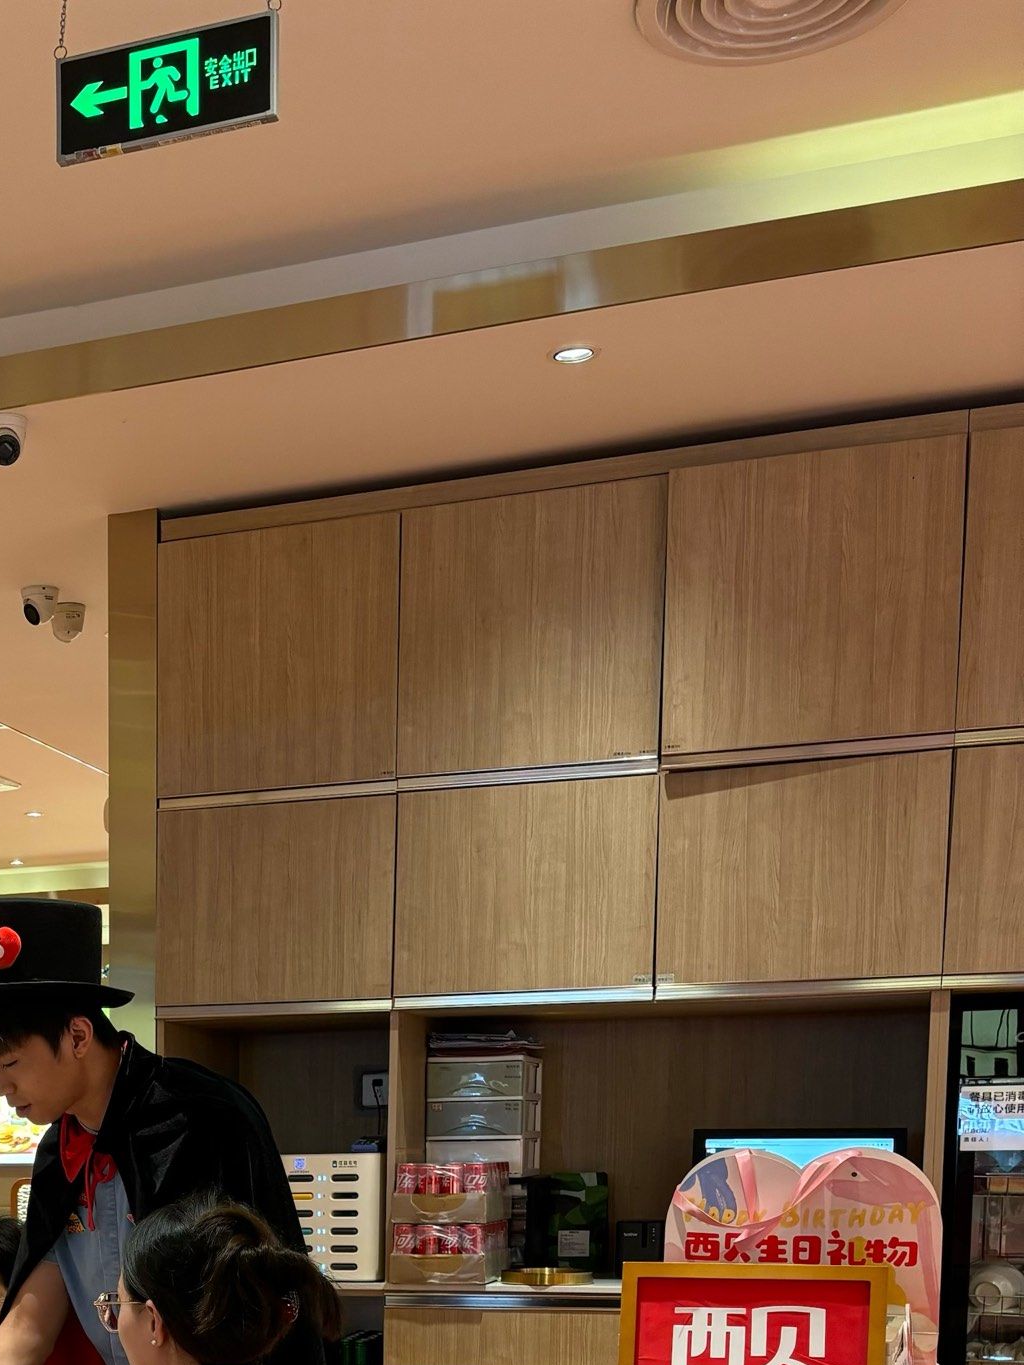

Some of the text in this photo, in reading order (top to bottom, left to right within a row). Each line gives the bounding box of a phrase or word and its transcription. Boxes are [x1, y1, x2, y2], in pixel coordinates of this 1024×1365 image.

[204, 48, 257, 77] 安全出口
[209, 68, 252, 90] EXIT
[780, 1200, 926, 1229] BIRTHDAY
[685, 1229, 919, 1267] 西贝生日礼物
